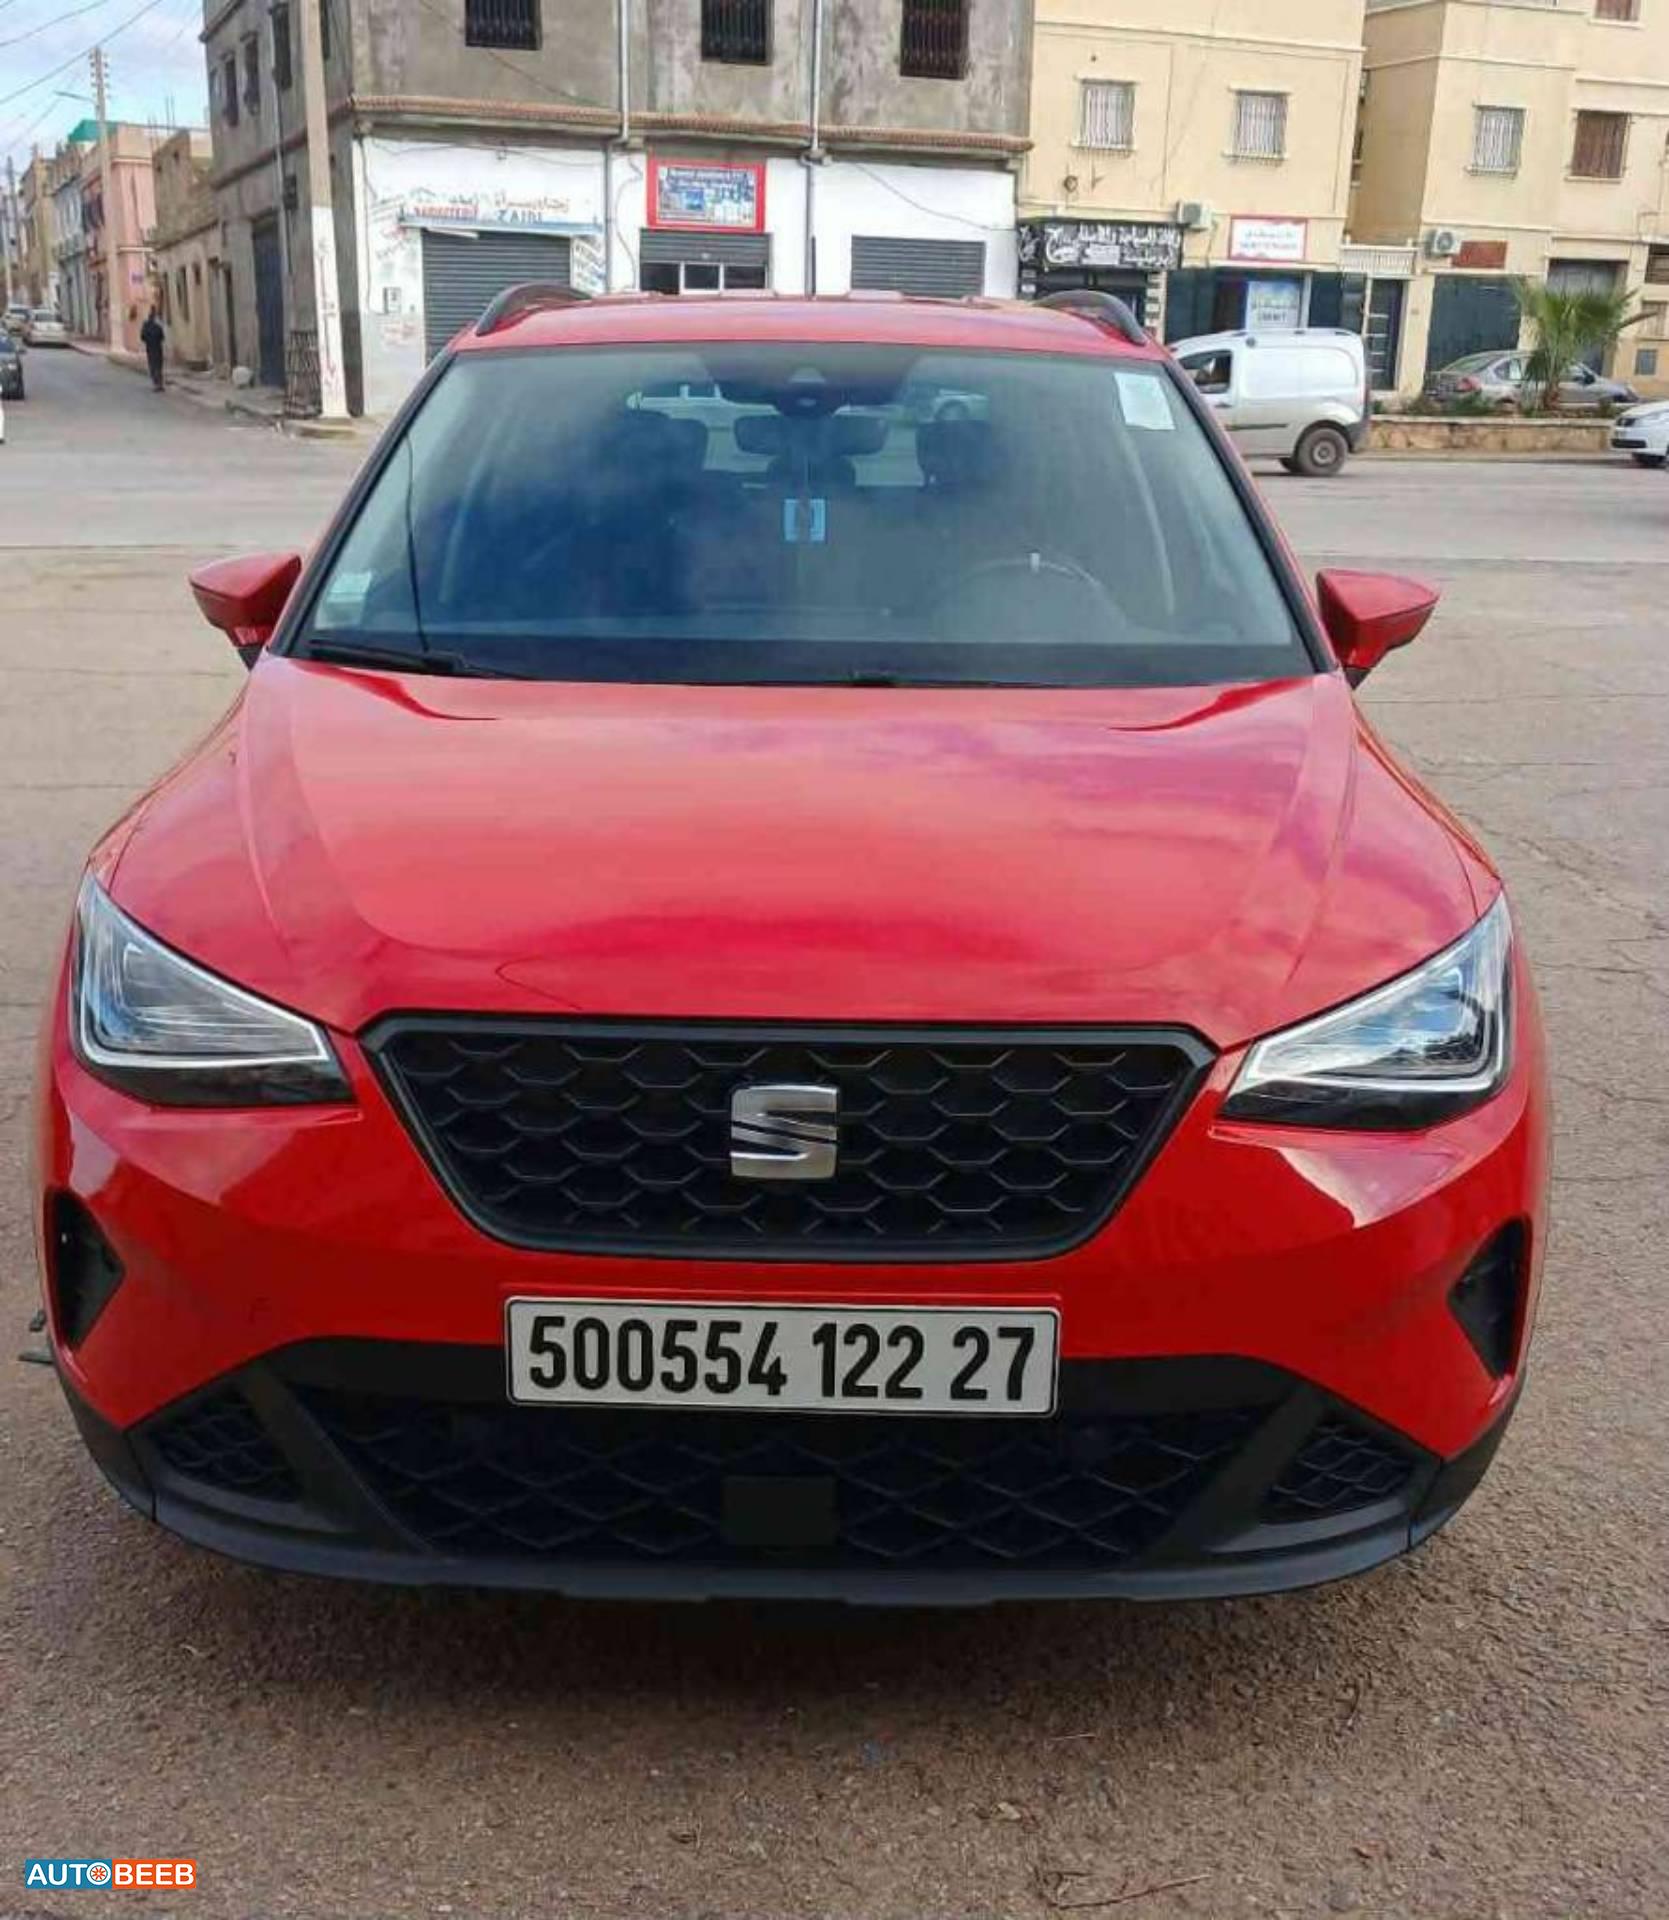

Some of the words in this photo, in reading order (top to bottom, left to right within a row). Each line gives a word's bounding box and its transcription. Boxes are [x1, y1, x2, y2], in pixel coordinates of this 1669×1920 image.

[529, 1315, 788, 1396] 500554
[812, 1323, 925, 1400] 122
[950, 1326, 1036, 1401] 27
